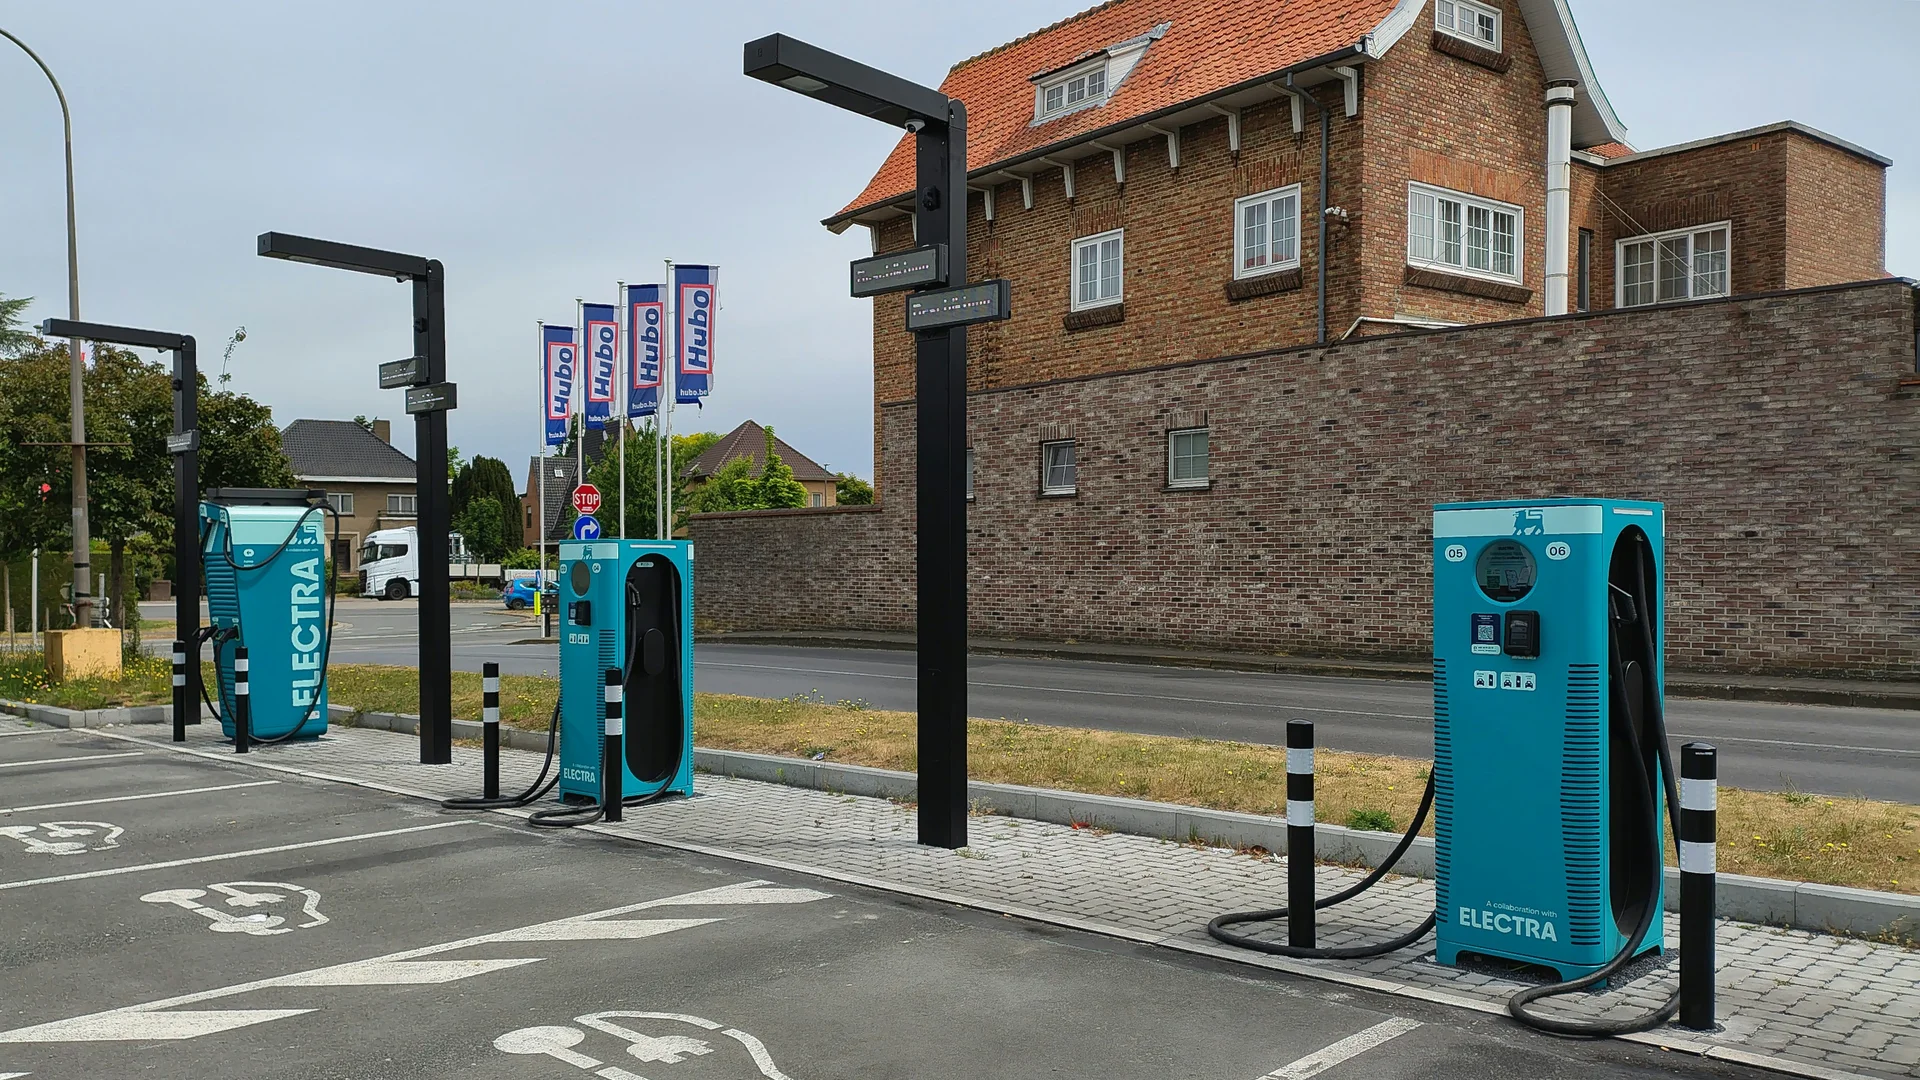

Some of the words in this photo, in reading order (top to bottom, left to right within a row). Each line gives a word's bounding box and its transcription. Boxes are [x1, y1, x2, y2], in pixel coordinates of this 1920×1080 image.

[687, 290, 710, 369] Hubo
[640, 307, 660, 382] Hubo
[594, 326, 614, 397] Hubo
[553, 347, 573, 414] Hubo
[680, 388, 708, 396] hubo.be
[631, 400, 657, 410] hubo.be
[574, 493, 599, 505] STOP
[1448, 548, 1463, 558] 05
[1549, 546, 1566, 556] 06
[290, 557, 321, 707] ELECTRA
[563, 767, 596, 784] ELECTRA
[1493, 902, 1540, 916] collaboration
[1541, 910, 1558, 919] with
[1459, 906, 1558, 943] ELECTRA
